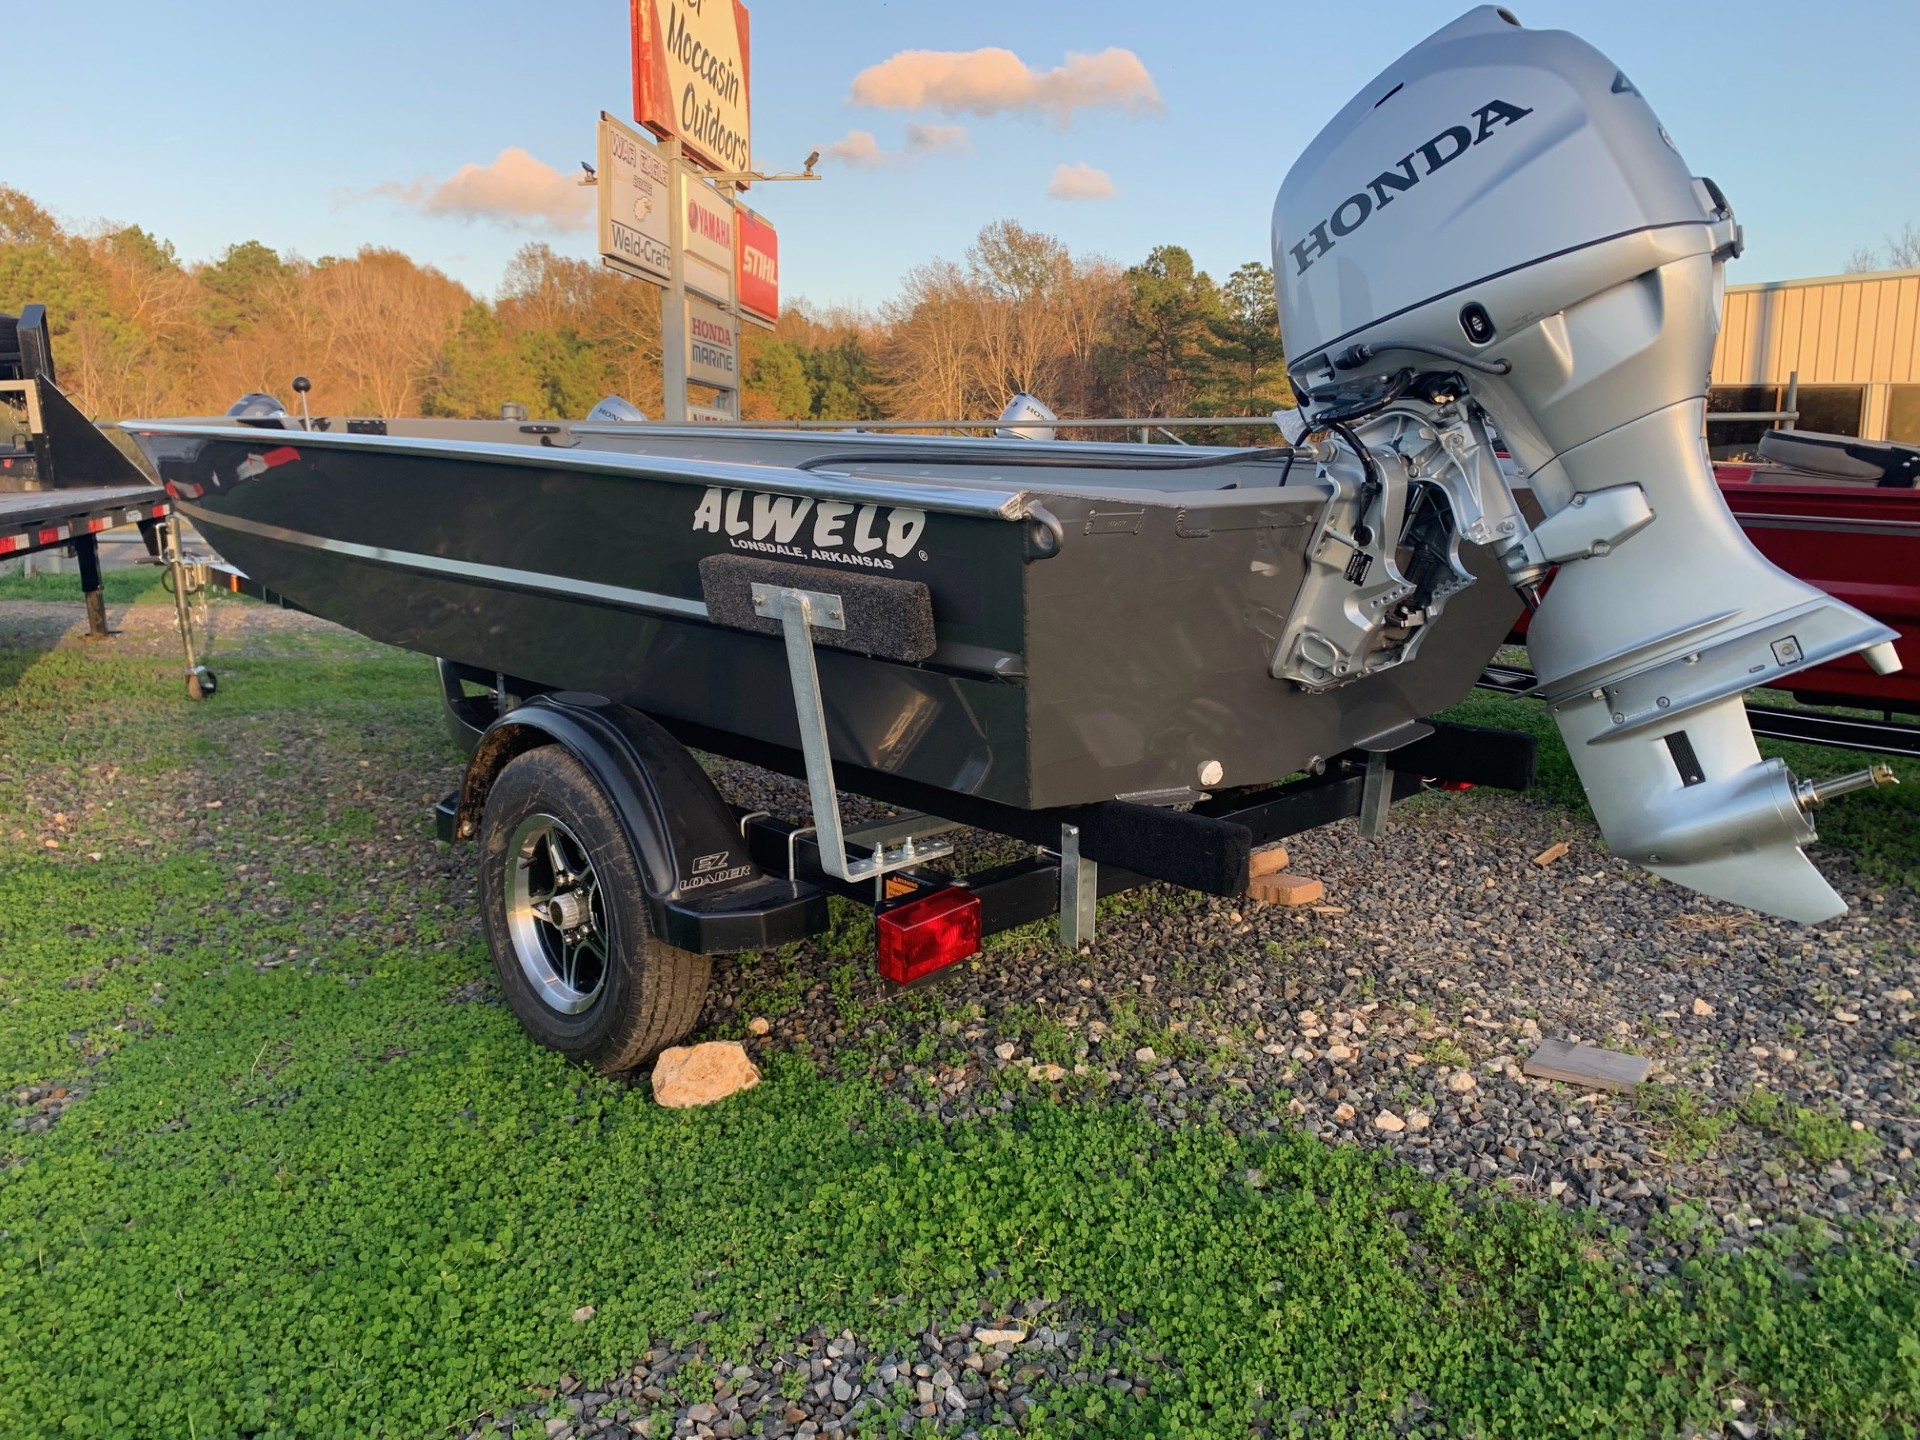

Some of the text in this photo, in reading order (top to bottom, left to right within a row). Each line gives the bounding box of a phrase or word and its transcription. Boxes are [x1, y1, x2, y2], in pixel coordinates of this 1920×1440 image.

[667, 1, 739, 109] Moccasin
[682, 82, 747, 172] Outdoors
[1289, 99, 1534, 276] HONDA
[611, 224, 671, 271] Weld-Craft
[699, 205, 731, 251] YAMAHA
[743, 244, 778, 286] STIHL
[692, 317, 732, 346] HONDA
[692, 344, 733, 372] MARINE
[598, 407, 625, 421] HON
[692, 487, 926, 558] ALWELD
[729, 538, 895, 570] LONSDALE, ARKANSAS
[680, 865, 751, 890] LOADER
[692, 851, 729, 874] EZ
